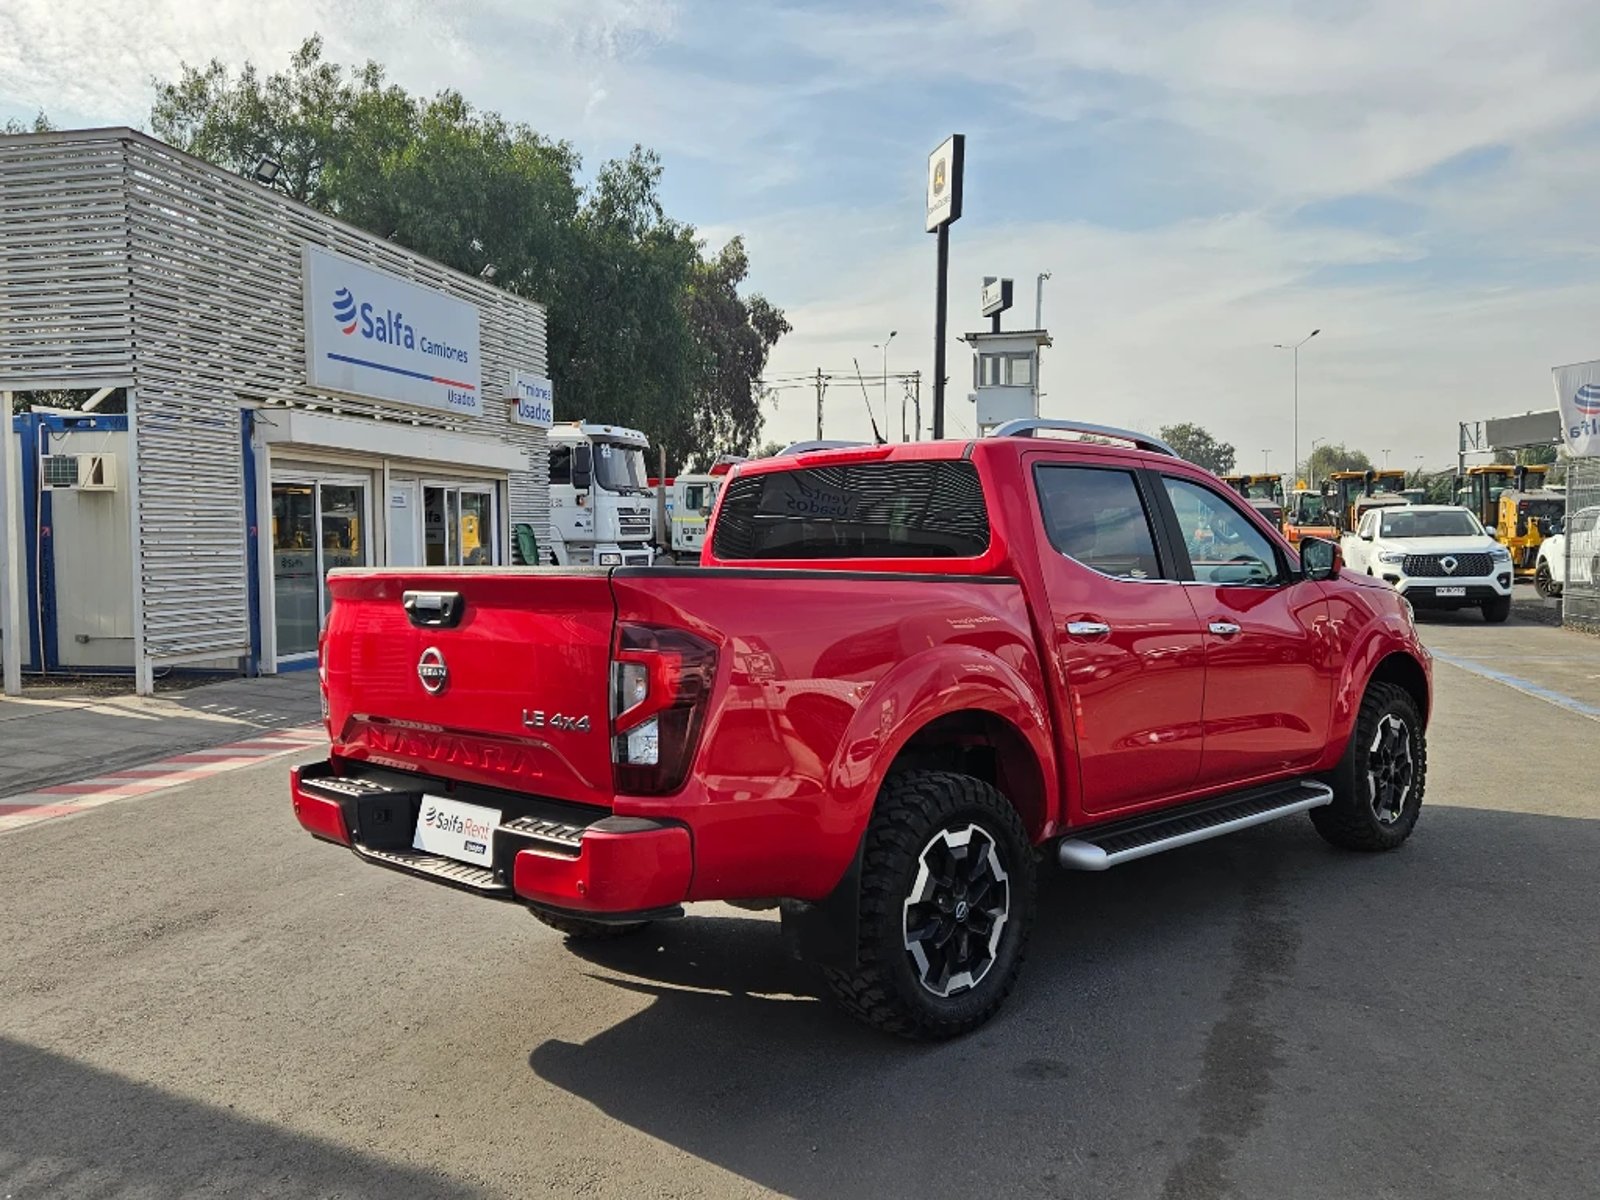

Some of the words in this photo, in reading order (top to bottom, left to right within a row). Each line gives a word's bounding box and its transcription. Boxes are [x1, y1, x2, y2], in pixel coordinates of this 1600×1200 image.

[361, 303, 415, 351] Salfa
[420, 336, 468, 363] Camiones
[447, 388, 476, 407] Usados
[518, 401, 551, 423] Usados
[424, 511, 441, 523] lfa
[522, 708, 545, 727] LE
[550, 712, 591, 732] 4x4
[366, 726, 543, 778] NAVARA
